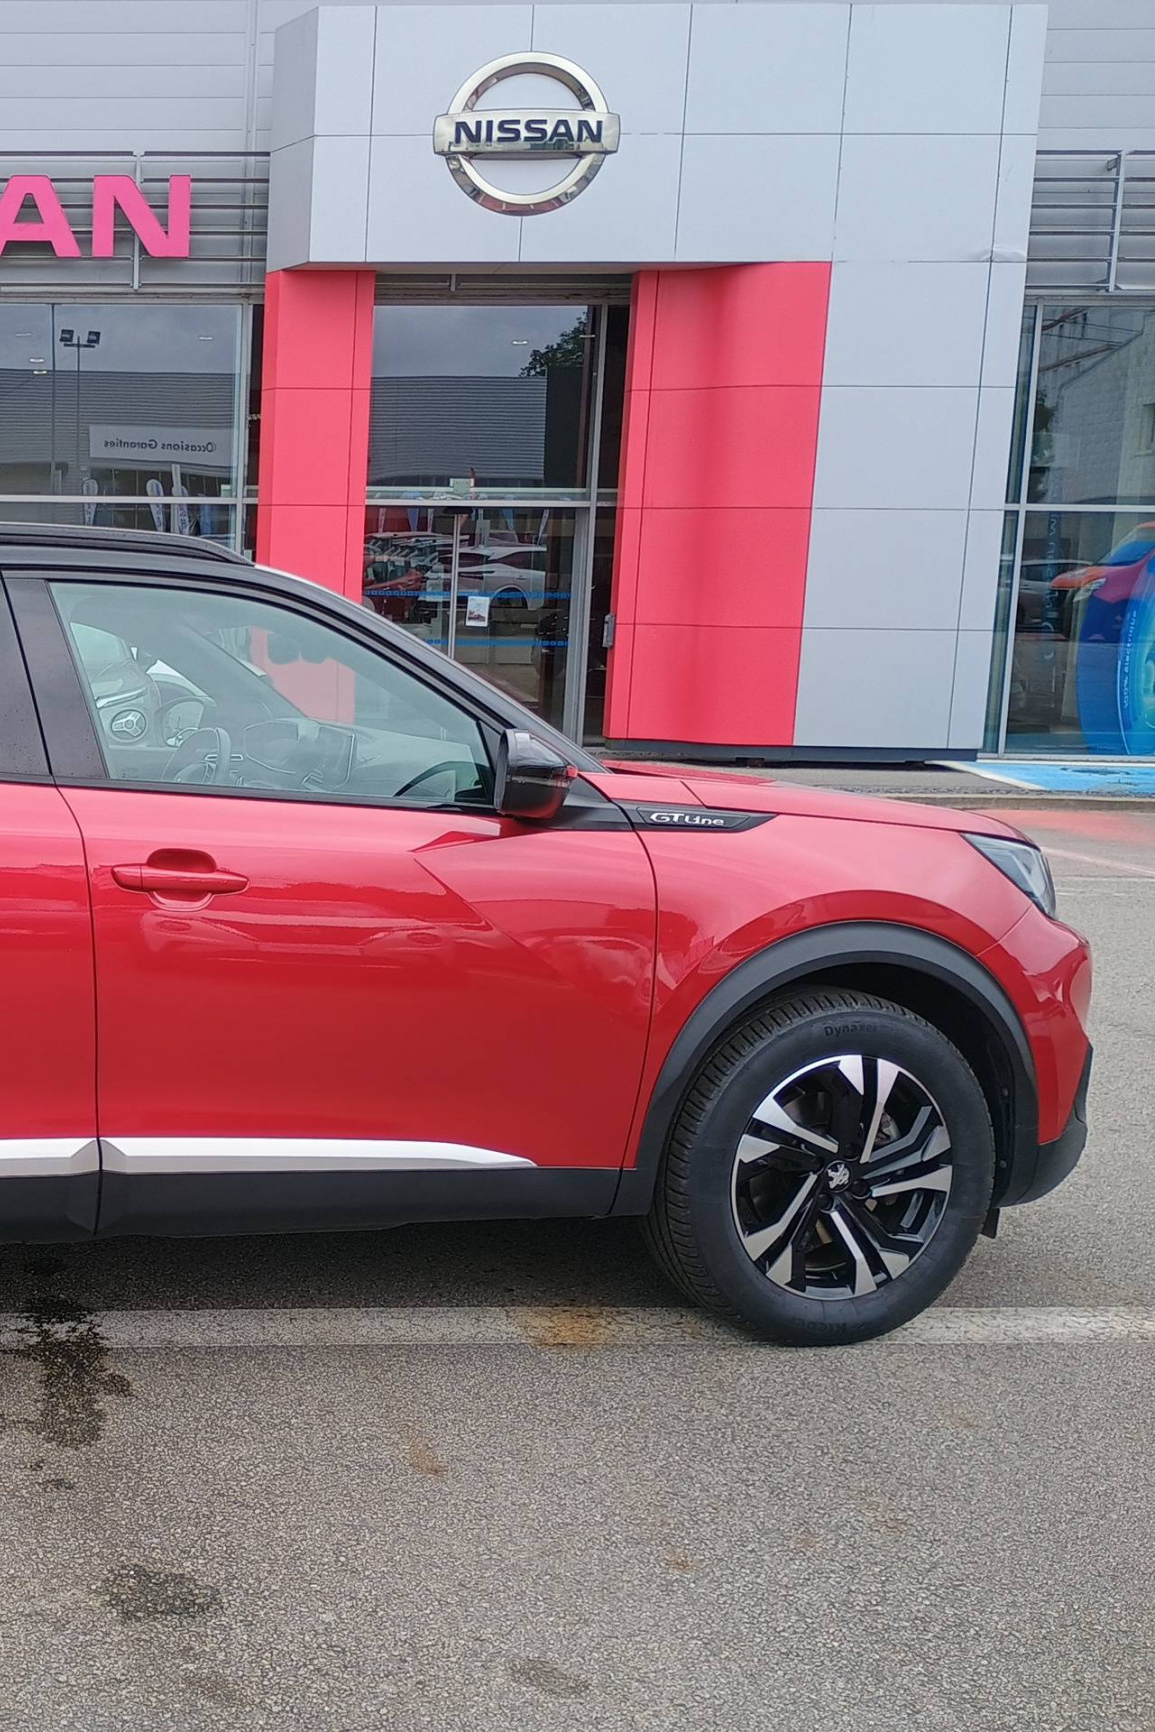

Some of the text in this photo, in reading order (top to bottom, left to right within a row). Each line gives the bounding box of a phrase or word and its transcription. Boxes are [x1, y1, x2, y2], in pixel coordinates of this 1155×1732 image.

[454, 119, 603, 144] NISSAN
[650, 812, 724, 826] GT Line
